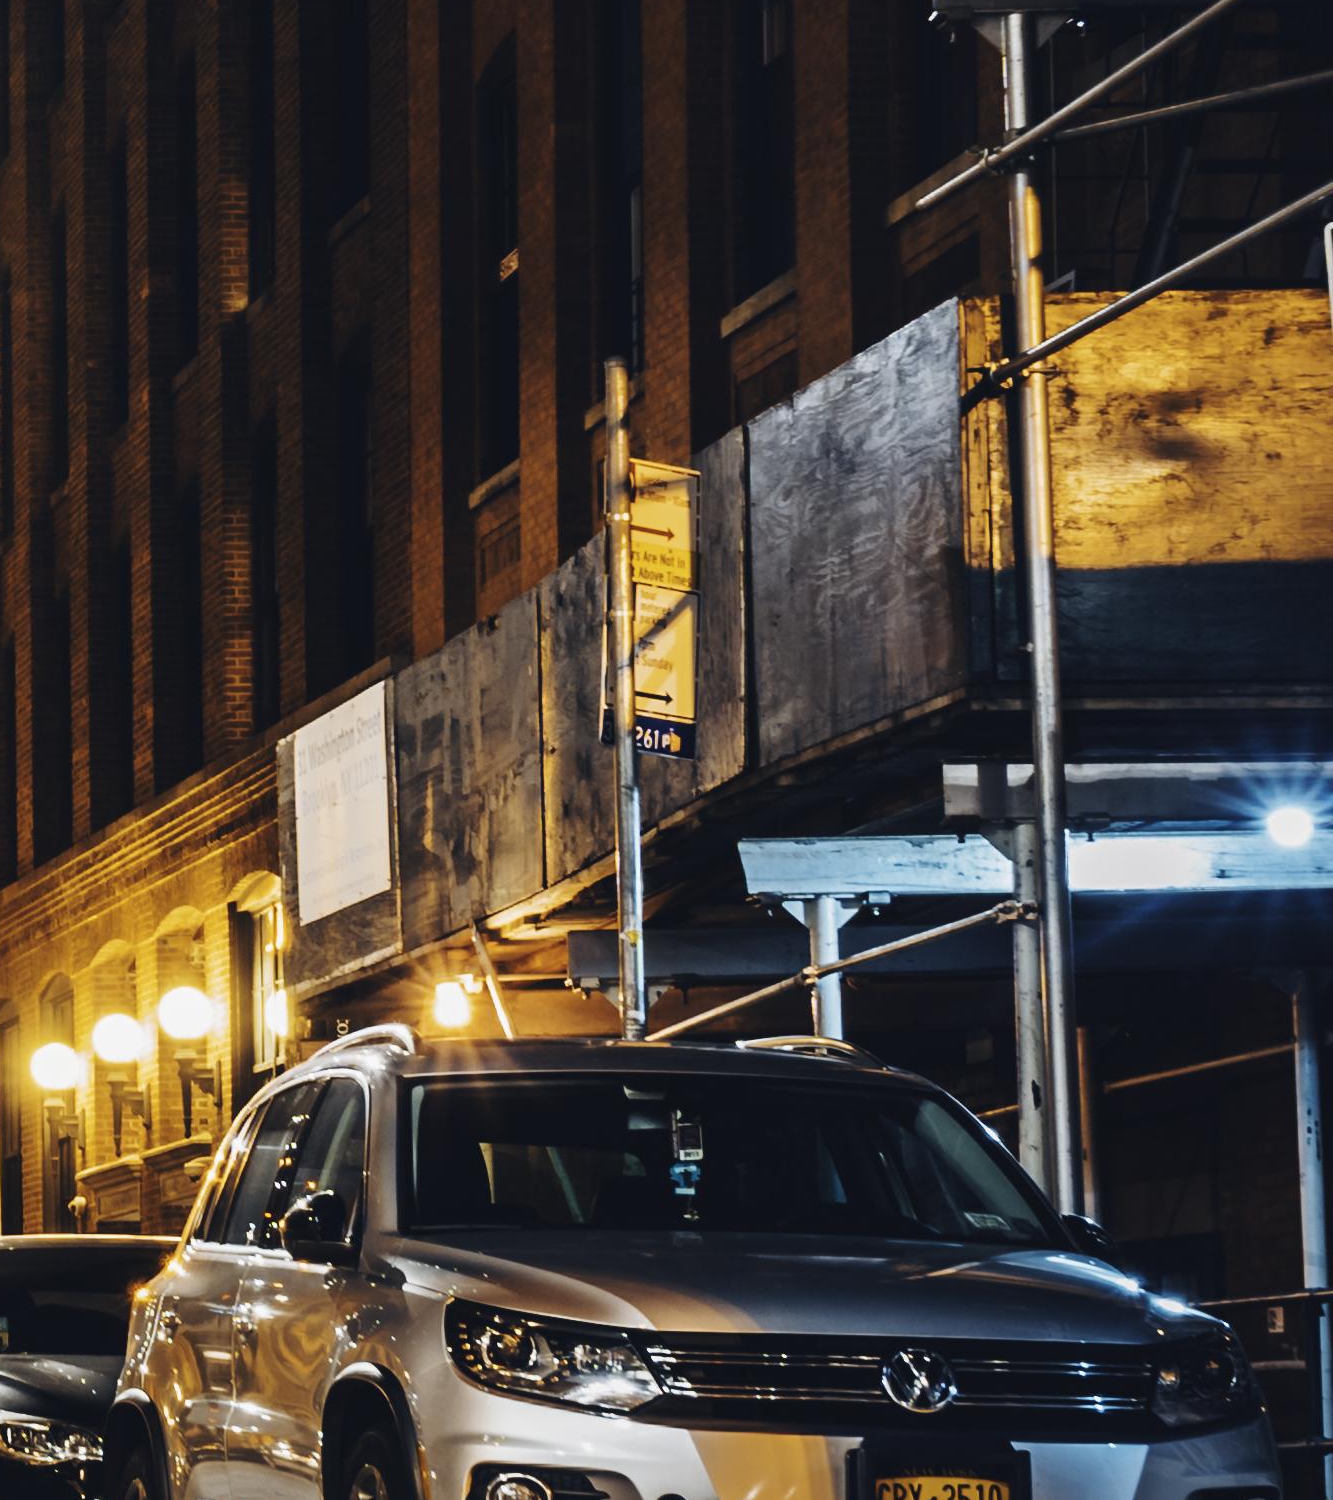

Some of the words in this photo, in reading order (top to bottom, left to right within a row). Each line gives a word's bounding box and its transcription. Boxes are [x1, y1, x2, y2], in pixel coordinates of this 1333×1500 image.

[639, 567, 664, 582] Above
[642, 654, 673, 672] Sunday
[356, 708, 381, 744] Street
